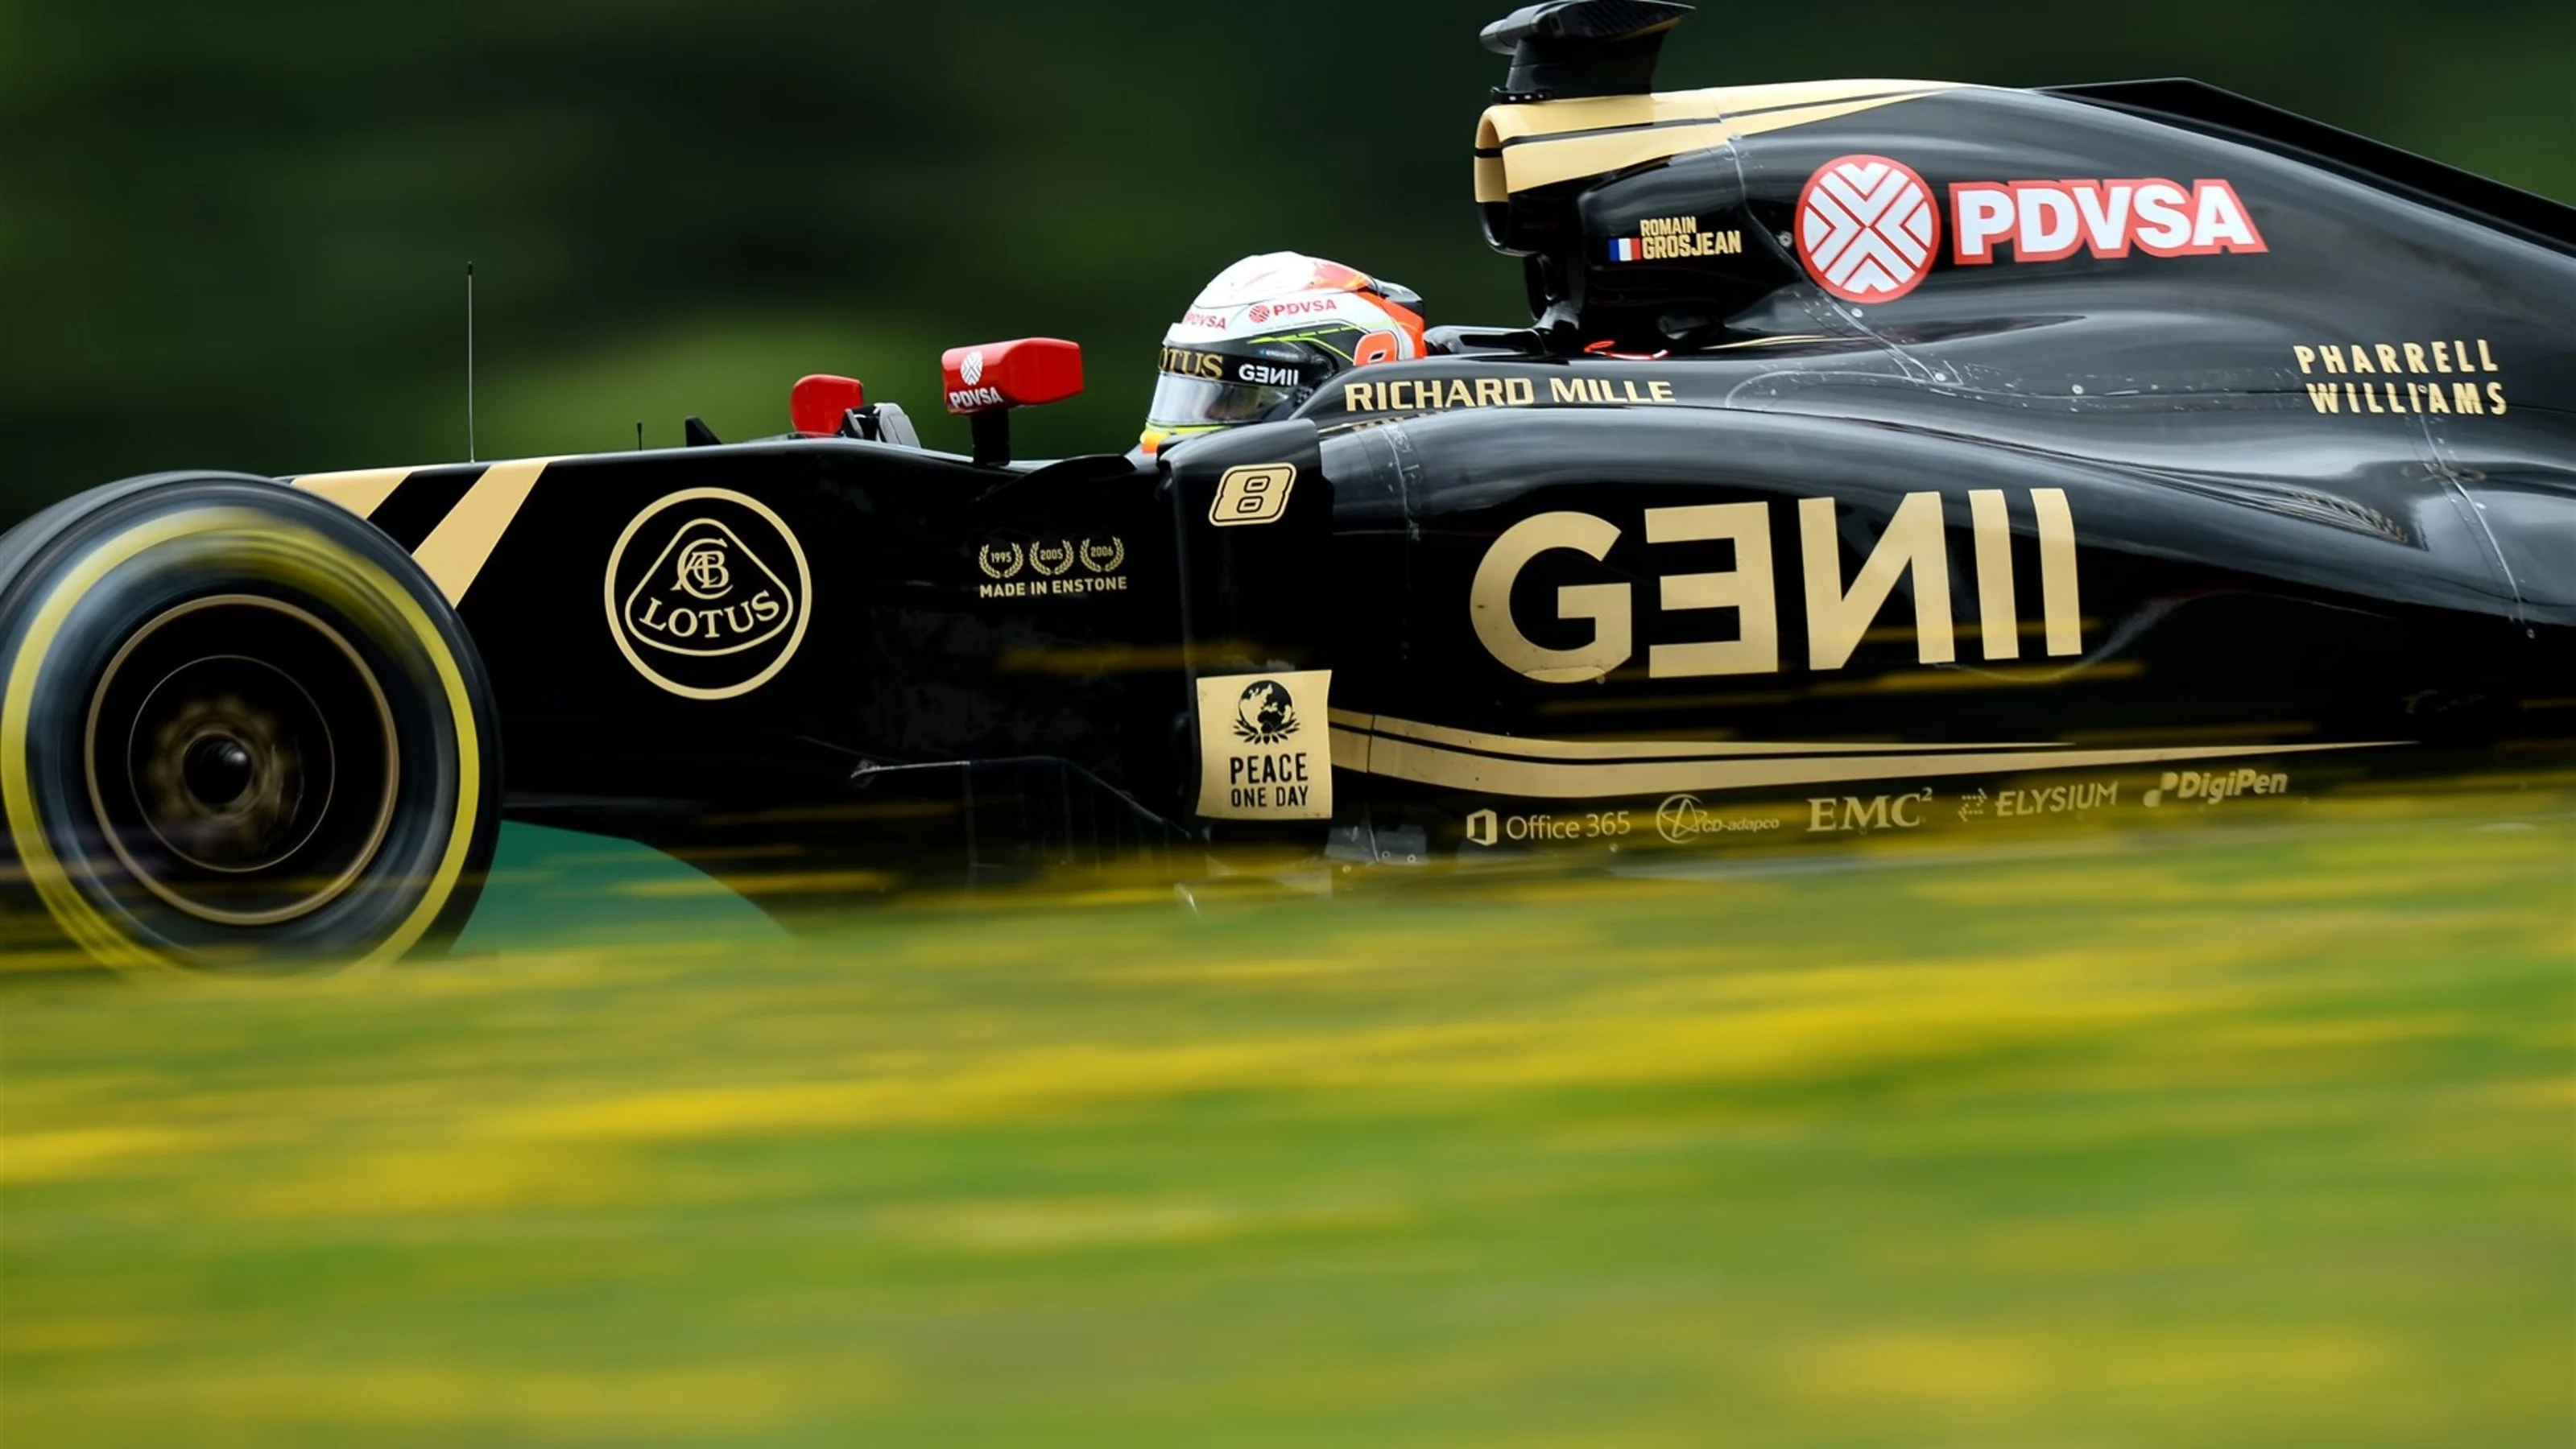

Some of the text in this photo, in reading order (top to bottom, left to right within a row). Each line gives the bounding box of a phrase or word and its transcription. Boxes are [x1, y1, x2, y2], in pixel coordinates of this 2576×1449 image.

[1639, 216, 1697, 237] ROMAIN
[1950, 180, 2266, 262] PDVSA
[1641, 229, 1742, 260] GROSJEAN
[1273, 299, 1338, 316] PDVSA
[1159, 347, 1223, 379] OTUS
[2293, 339, 2499, 374] PHARRELL
[949, 386, 1003, 409] PDVSA
[1344, 378, 1677, 411] RICHARD MILLE
[2305, 382, 2507, 415] WILLIAMS
[1209, 462, 1296, 526] 8
[990, 551, 1012, 564] 1995
[1040, 548, 1064, 561] 2005
[1090, 546, 1114, 558] 2006
[979, 576, 1127, 598] MADE IN ENSTONE
[1470, 487, 2082, 683] GENII
[639, 589, 780, 638] LOTUS
[1230, 752, 1309, 785] PEACE
[1230, 785, 1309, 807] ONE DAY
[1995, 780, 2119, 817] ELYSIUM
[2177, 768, 2289, 805] DigiPen
[1506, 811, 1631, 840] Office 365
